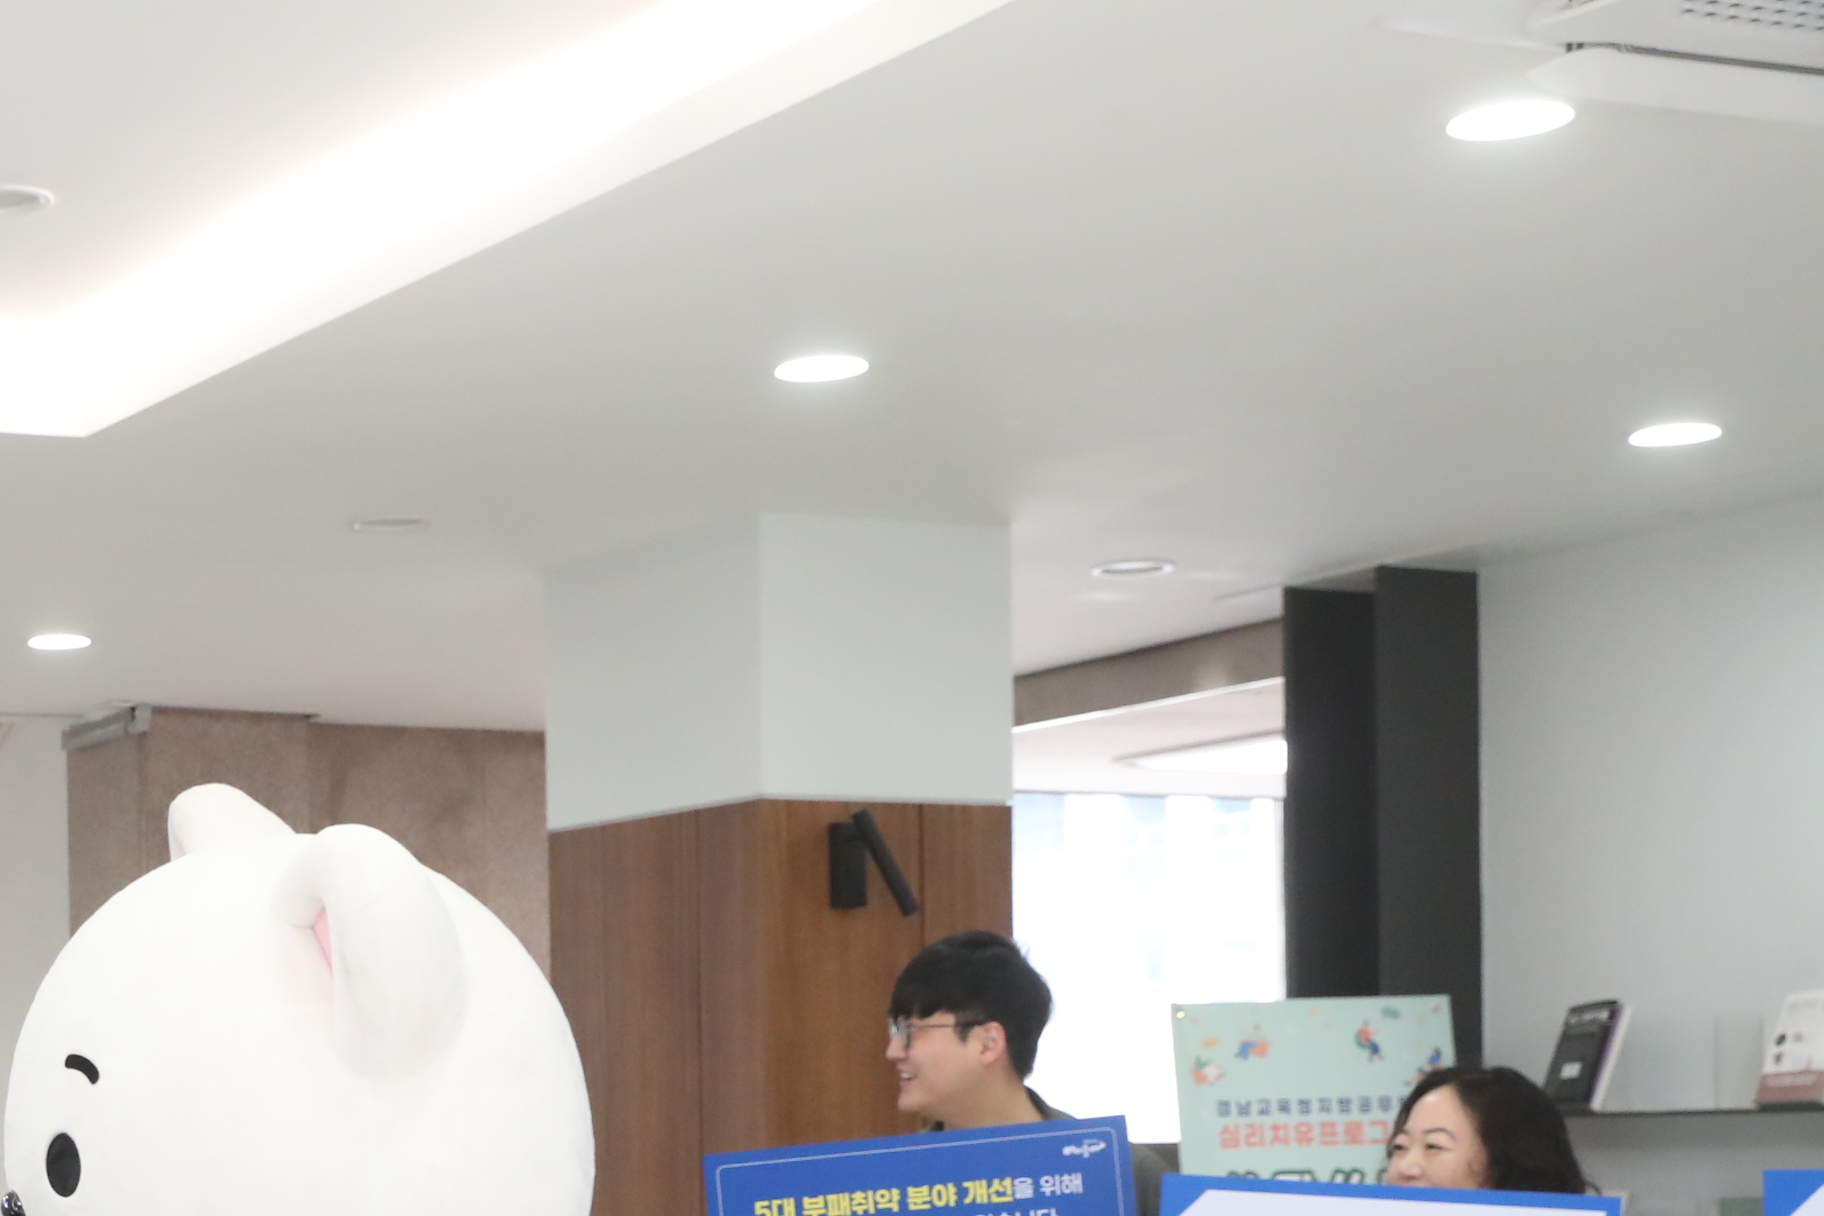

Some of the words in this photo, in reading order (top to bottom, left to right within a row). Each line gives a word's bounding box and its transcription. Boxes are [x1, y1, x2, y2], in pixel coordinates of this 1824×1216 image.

[1219, 1120, 1390, 1150] 심리치유프로그
[907, 1183, 958, 1211] 분야
[963, 1176, 1034, 1206] 개선을
[1039, 1172, 1084, 1197] 위해
